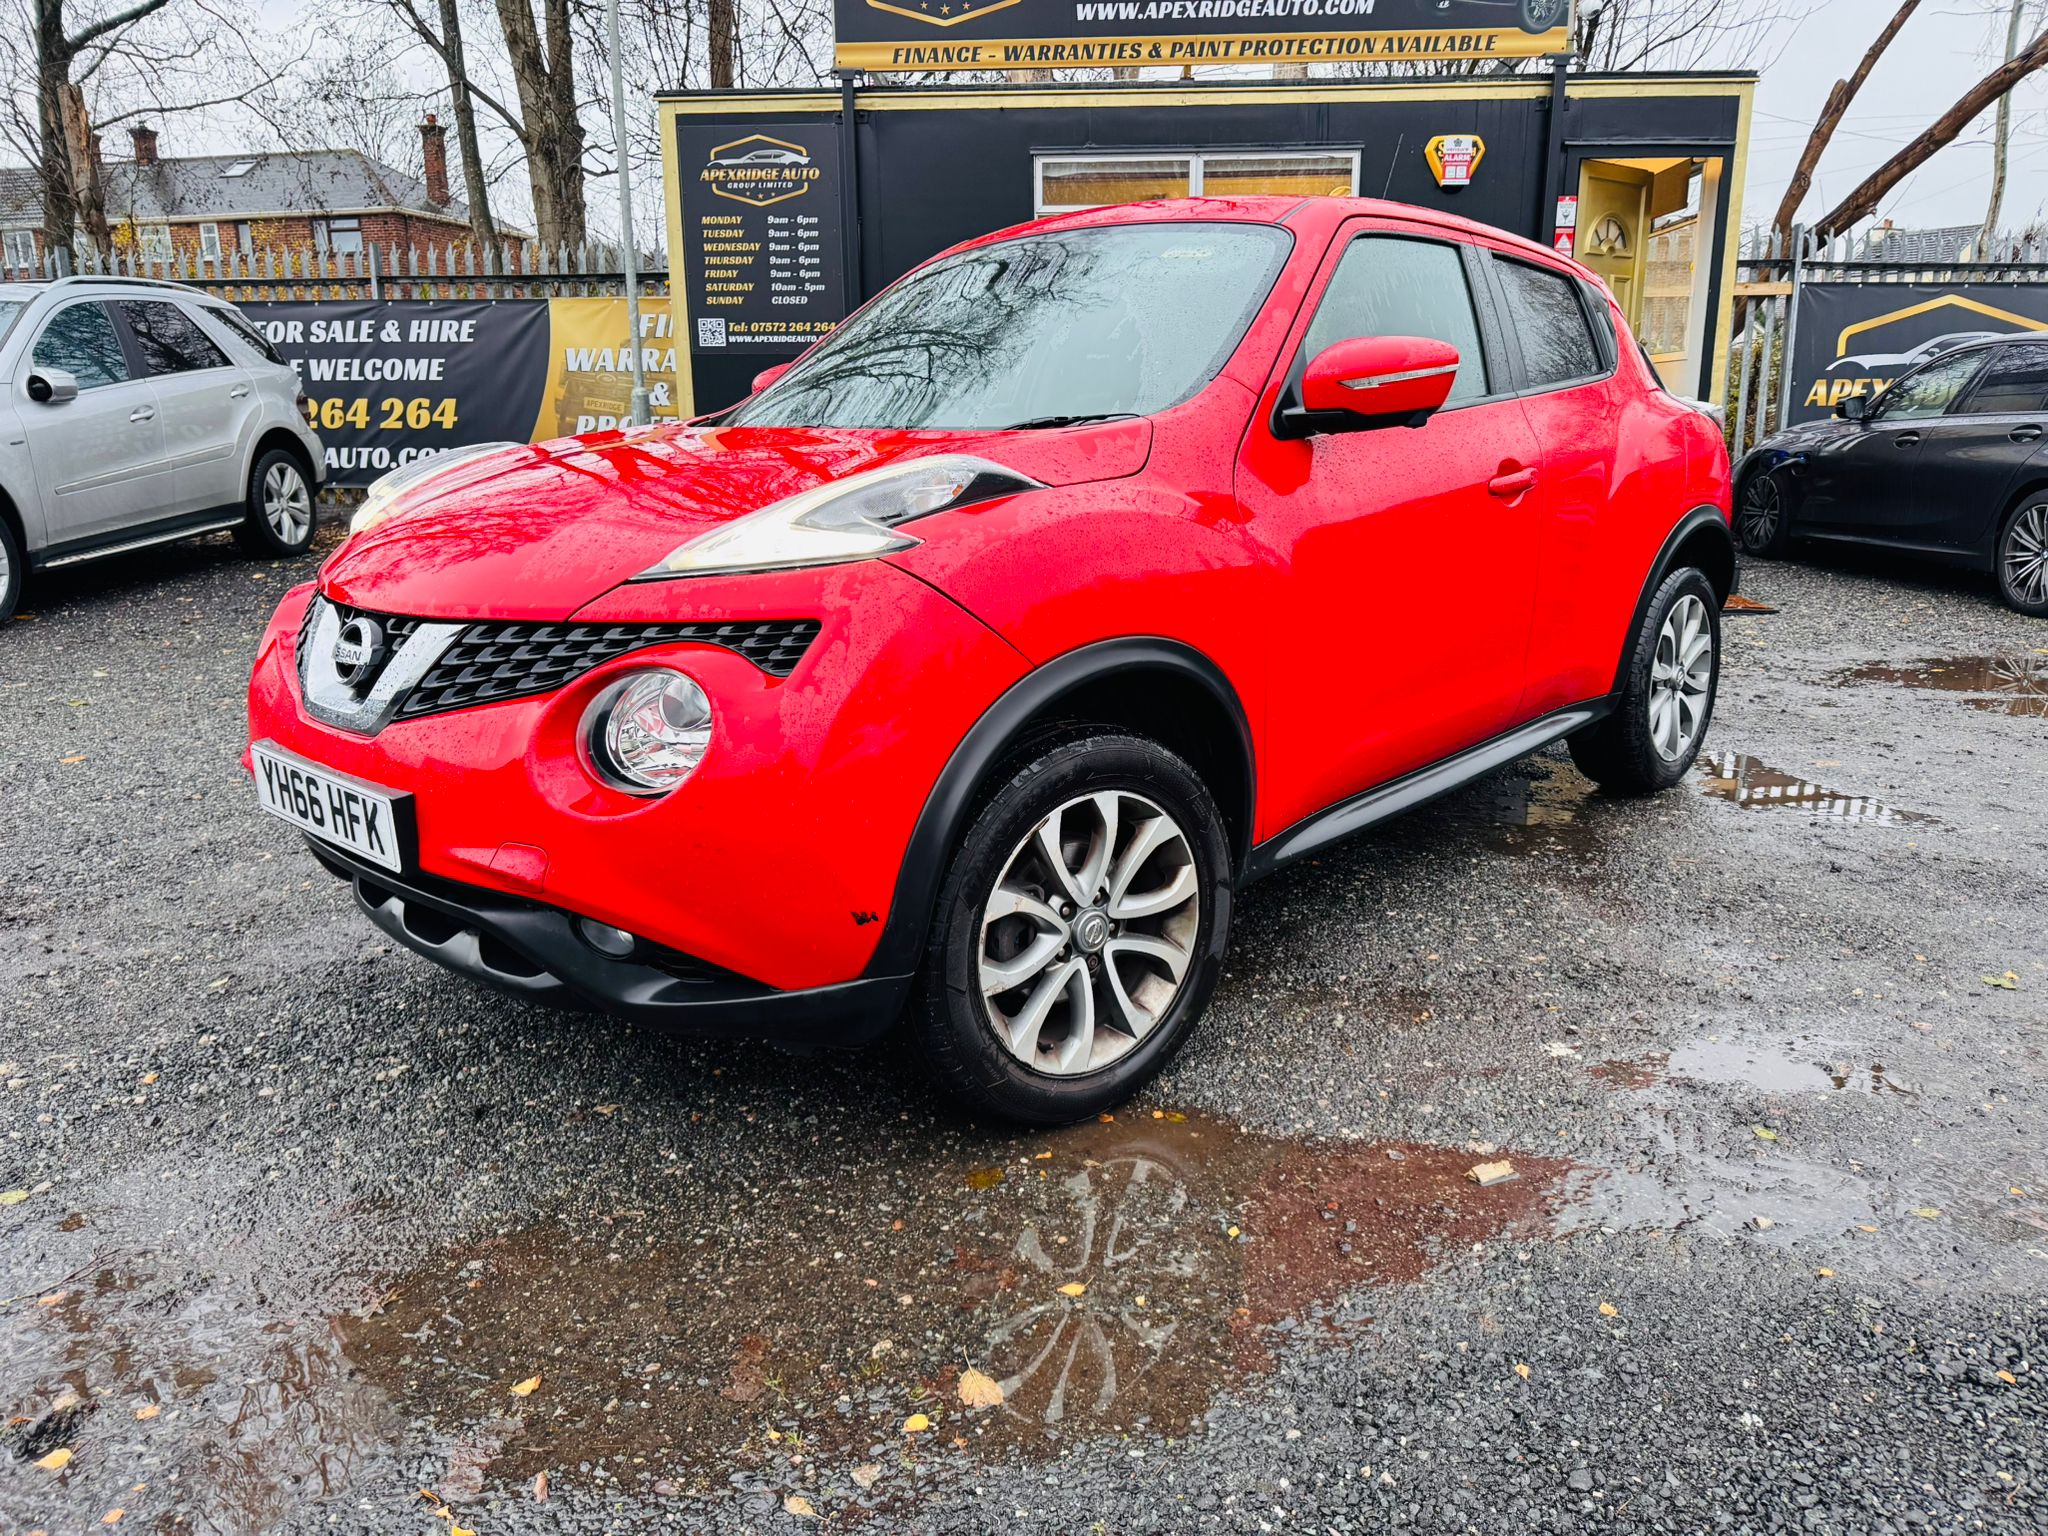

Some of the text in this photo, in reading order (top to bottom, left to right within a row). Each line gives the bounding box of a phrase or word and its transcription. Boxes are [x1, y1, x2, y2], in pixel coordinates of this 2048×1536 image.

[1076, 0, 1374, 20] WWW.APEXRIDGEAUTO.COM
[892, 46, 983, 64] FINANCE
[1003, 42, 1142, 61] WARRANTIES
[1148, 42, 1163, 59] &
[1170, 41, 1235, 58] PAINT
[1239, 38, 1377, 56] PROTECTION
[1381, 35, 1498, 53] AVAILABLE
[700, 168, 820, 181] APEXRIDGE AUTO
[701, 216, 742, 225] MONDAY
[767, 216, 788, 224] 9am
[797, 216, 818, 225] 6pm
[703, 229, 744, 238] TUESDAY
[768, 229, 789, 237] 9am
[798, 229, 819, 238] 6pm
[703, 242, 761, 251] WEDNESDAY
[768, 243, 789, 251] 9am
[798, 243, 819, 252] 6pm
[704, 256, 754, 265] THURSDAY
[769, 256, 790, 264] 9am
[799, 256, 820, 265] 6pm
[705, 270, 738, 278] FRIDAY
[770, 270, 791, 278] 9am
[800, 270, 821, 279] 6pm
[705, 283, 754, 291] SATURDAY
[771, 283, 797, 291] 10am
[804, 283, 825, 293] 5pm
[706, 296, 808, 305] SUNDAY CLOSED
[310, 320, 375, 343] SALE
[380, 320, 400, 343] &
[409, 320, 477, 343] HIRE
[728, 322, 836, 332] Tel: 07572 264 264
[309, 358, 445, 381] WELCOME
[649, 382, 671, 406] &
[380, 397, 458, 429] 264
[260, 755, 385, 855] YH66 HFK
